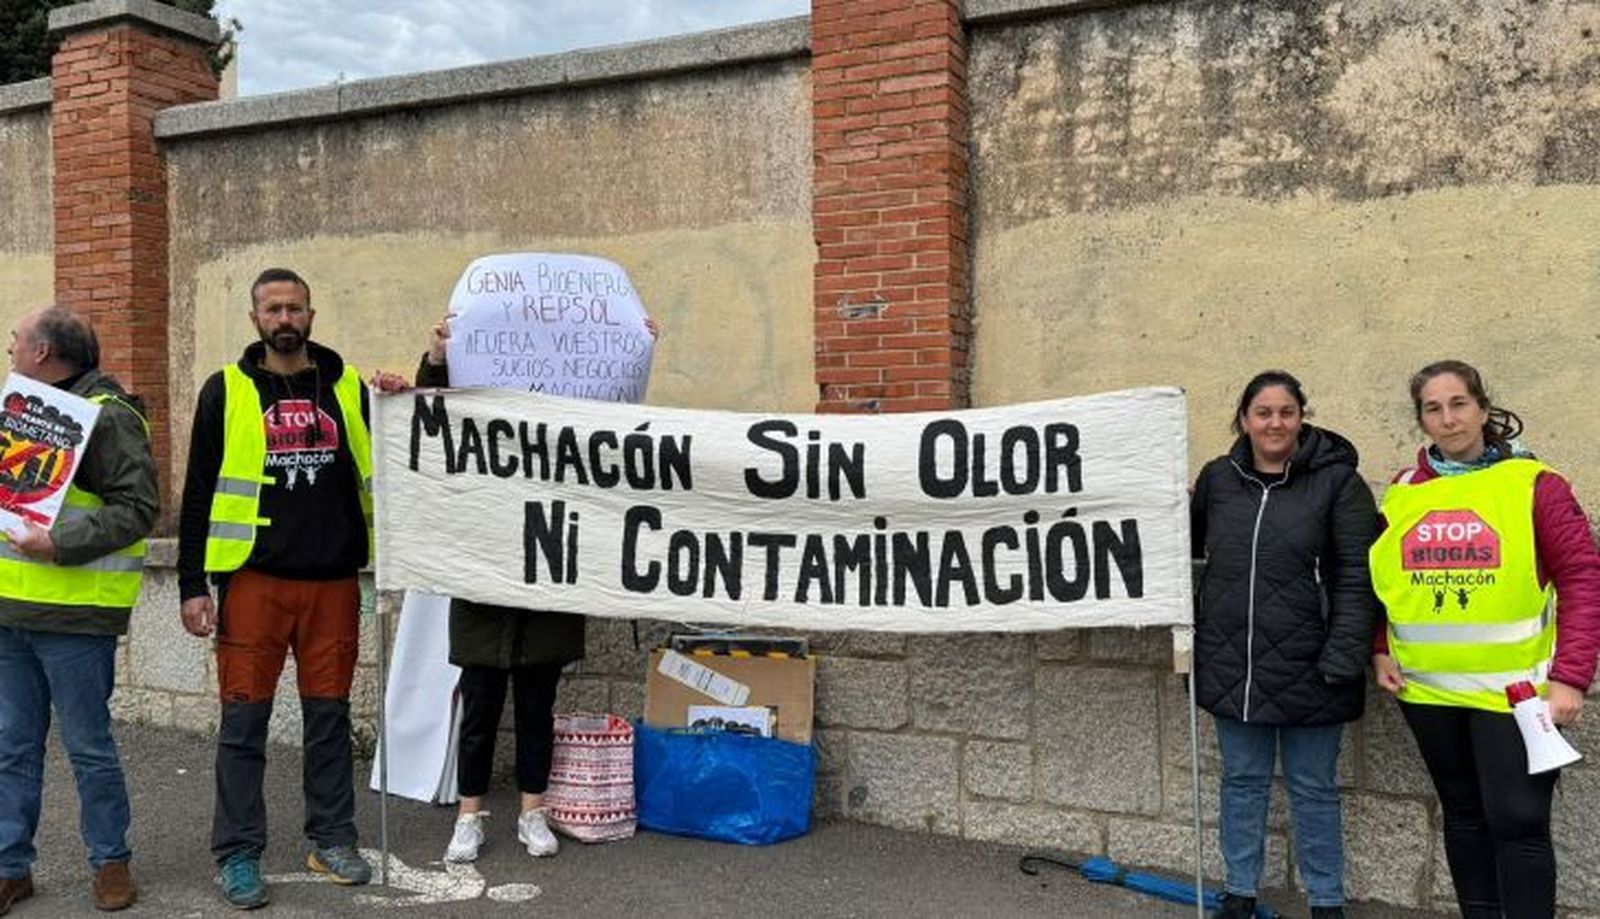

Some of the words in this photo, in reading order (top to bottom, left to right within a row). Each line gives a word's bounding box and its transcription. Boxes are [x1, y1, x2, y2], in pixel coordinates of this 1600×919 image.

[467, 265, 526, 295] GENIA
[538, 261, 635, 298] BIOENERG
[502, 300, 513, 322] Y
[522, 294, 620, 327] REPSOL
[551, 330, 648, 358] VUESTROS
[491, 357, 555, 378] SUCIOS
[562, 359, 644, 380] NEGOCIOS
[409, 393, 693, 491] MACHACÓN
[918, 418, 1083, 500] OLOR
[1417, 522, 1482, 542] STOP
[1410, 569, 1496, 585] Machacón
